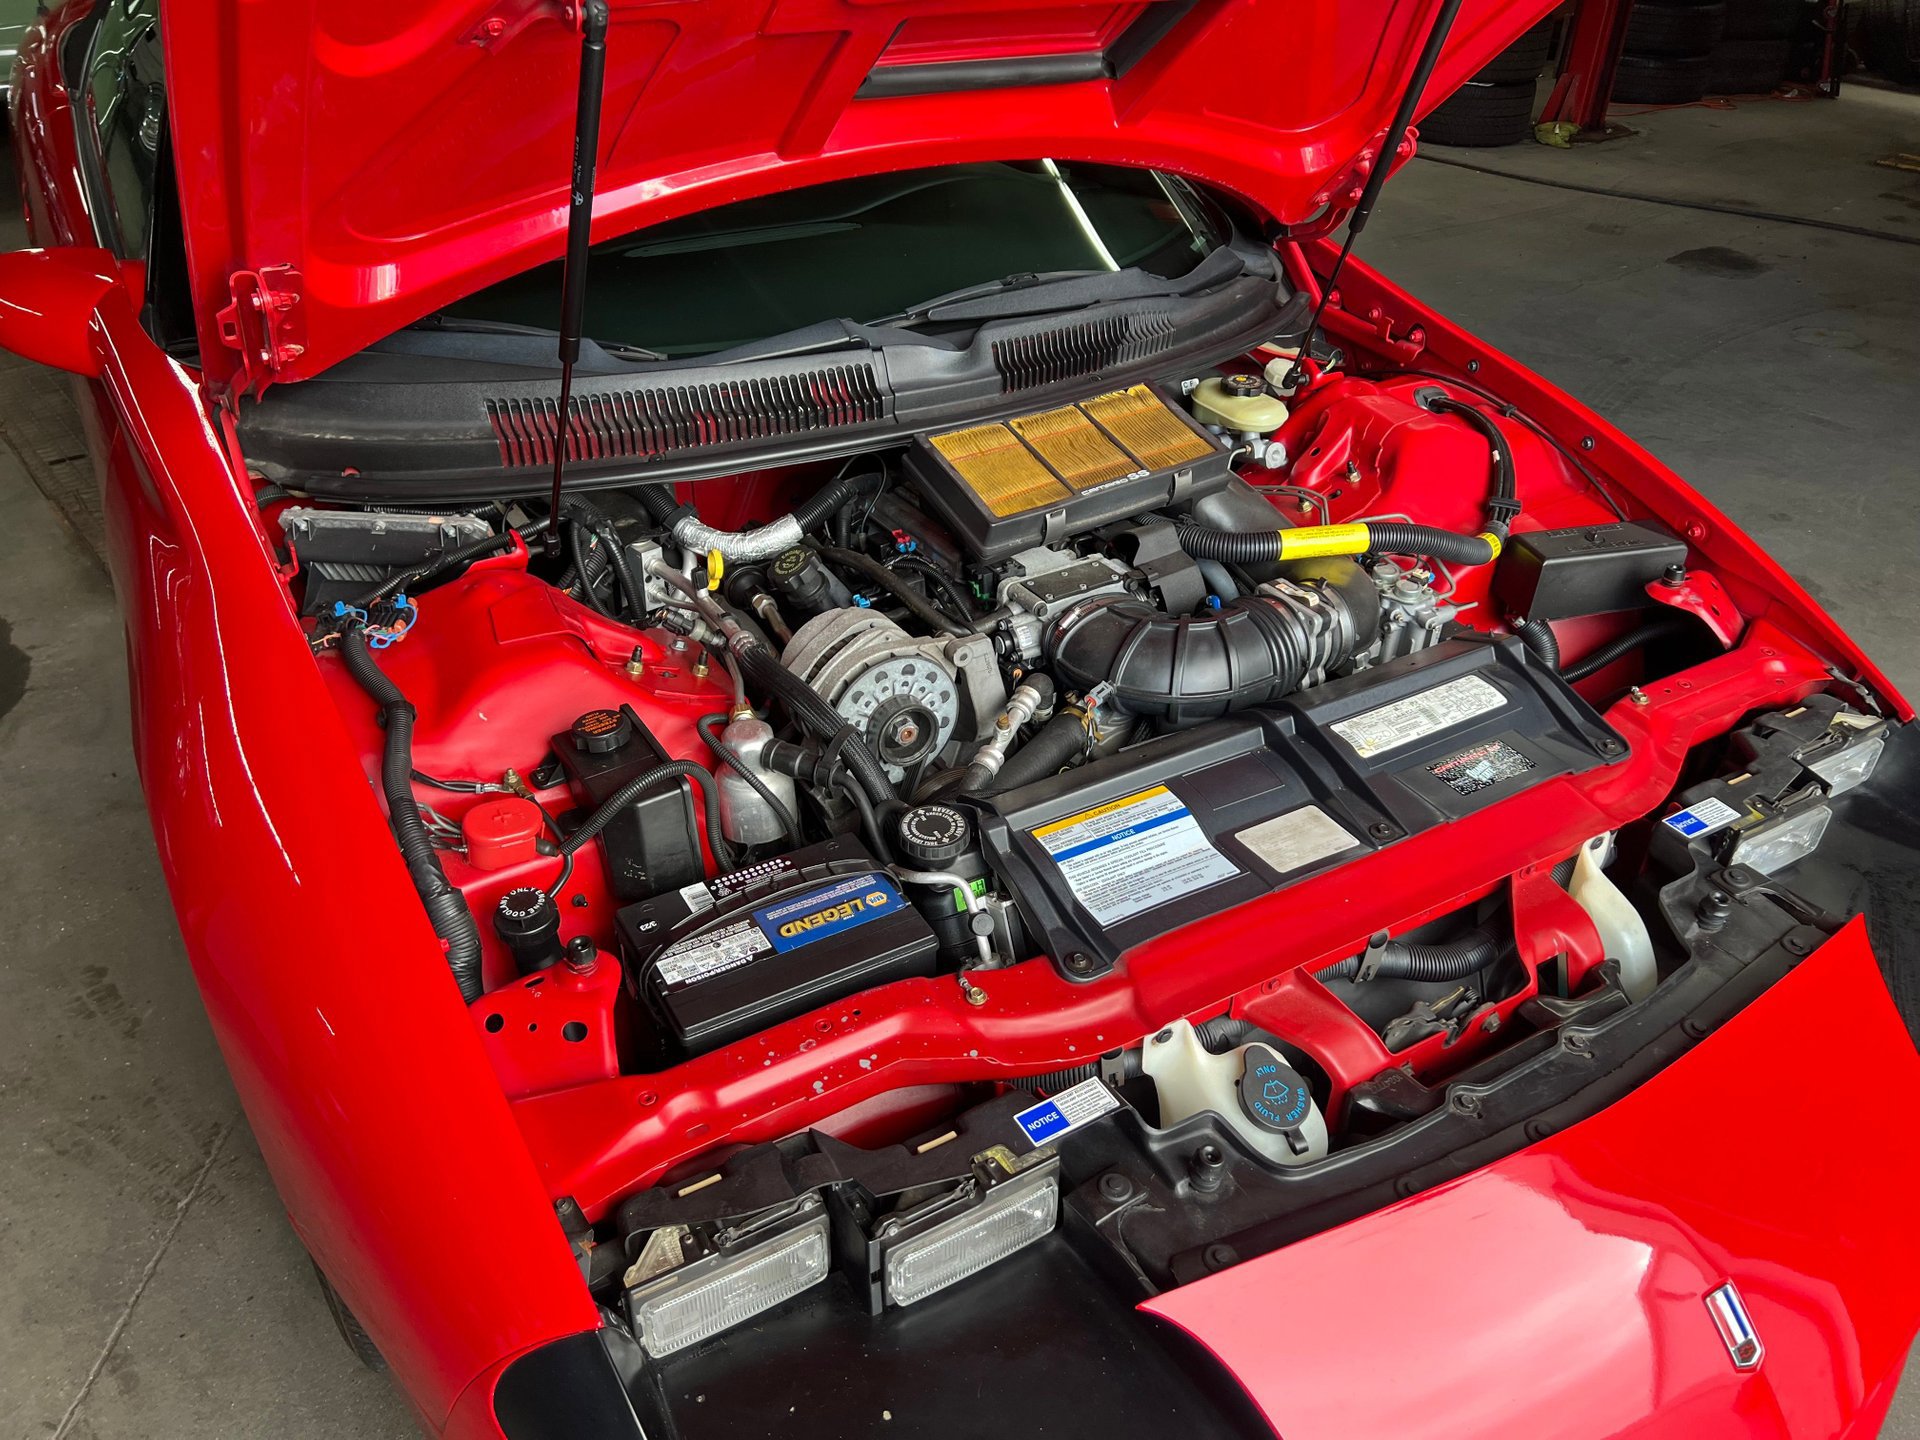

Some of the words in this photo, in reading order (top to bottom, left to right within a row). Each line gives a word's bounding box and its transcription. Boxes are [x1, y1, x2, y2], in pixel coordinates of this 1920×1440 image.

[1127, 470, 1150, 481] SS
[1092, 803, 1121, 816] CAUTION
[1111, 828, 1136, 842] NOTICE
[510, 887, 536, 896] ONLY
[527, 889, 546, 914] ENGINE
[500, 896, 526, 917] COOLANT
[780, 897, 866, 938] LEGEND
[1255, 1065, 1276, 1077] ONLY
[1253, 1100, 1281, 1122] FLUID
[1285, 1087, 1305, 1122] WASHER
[1027, 1110, 1060, 1132] NOTICE
